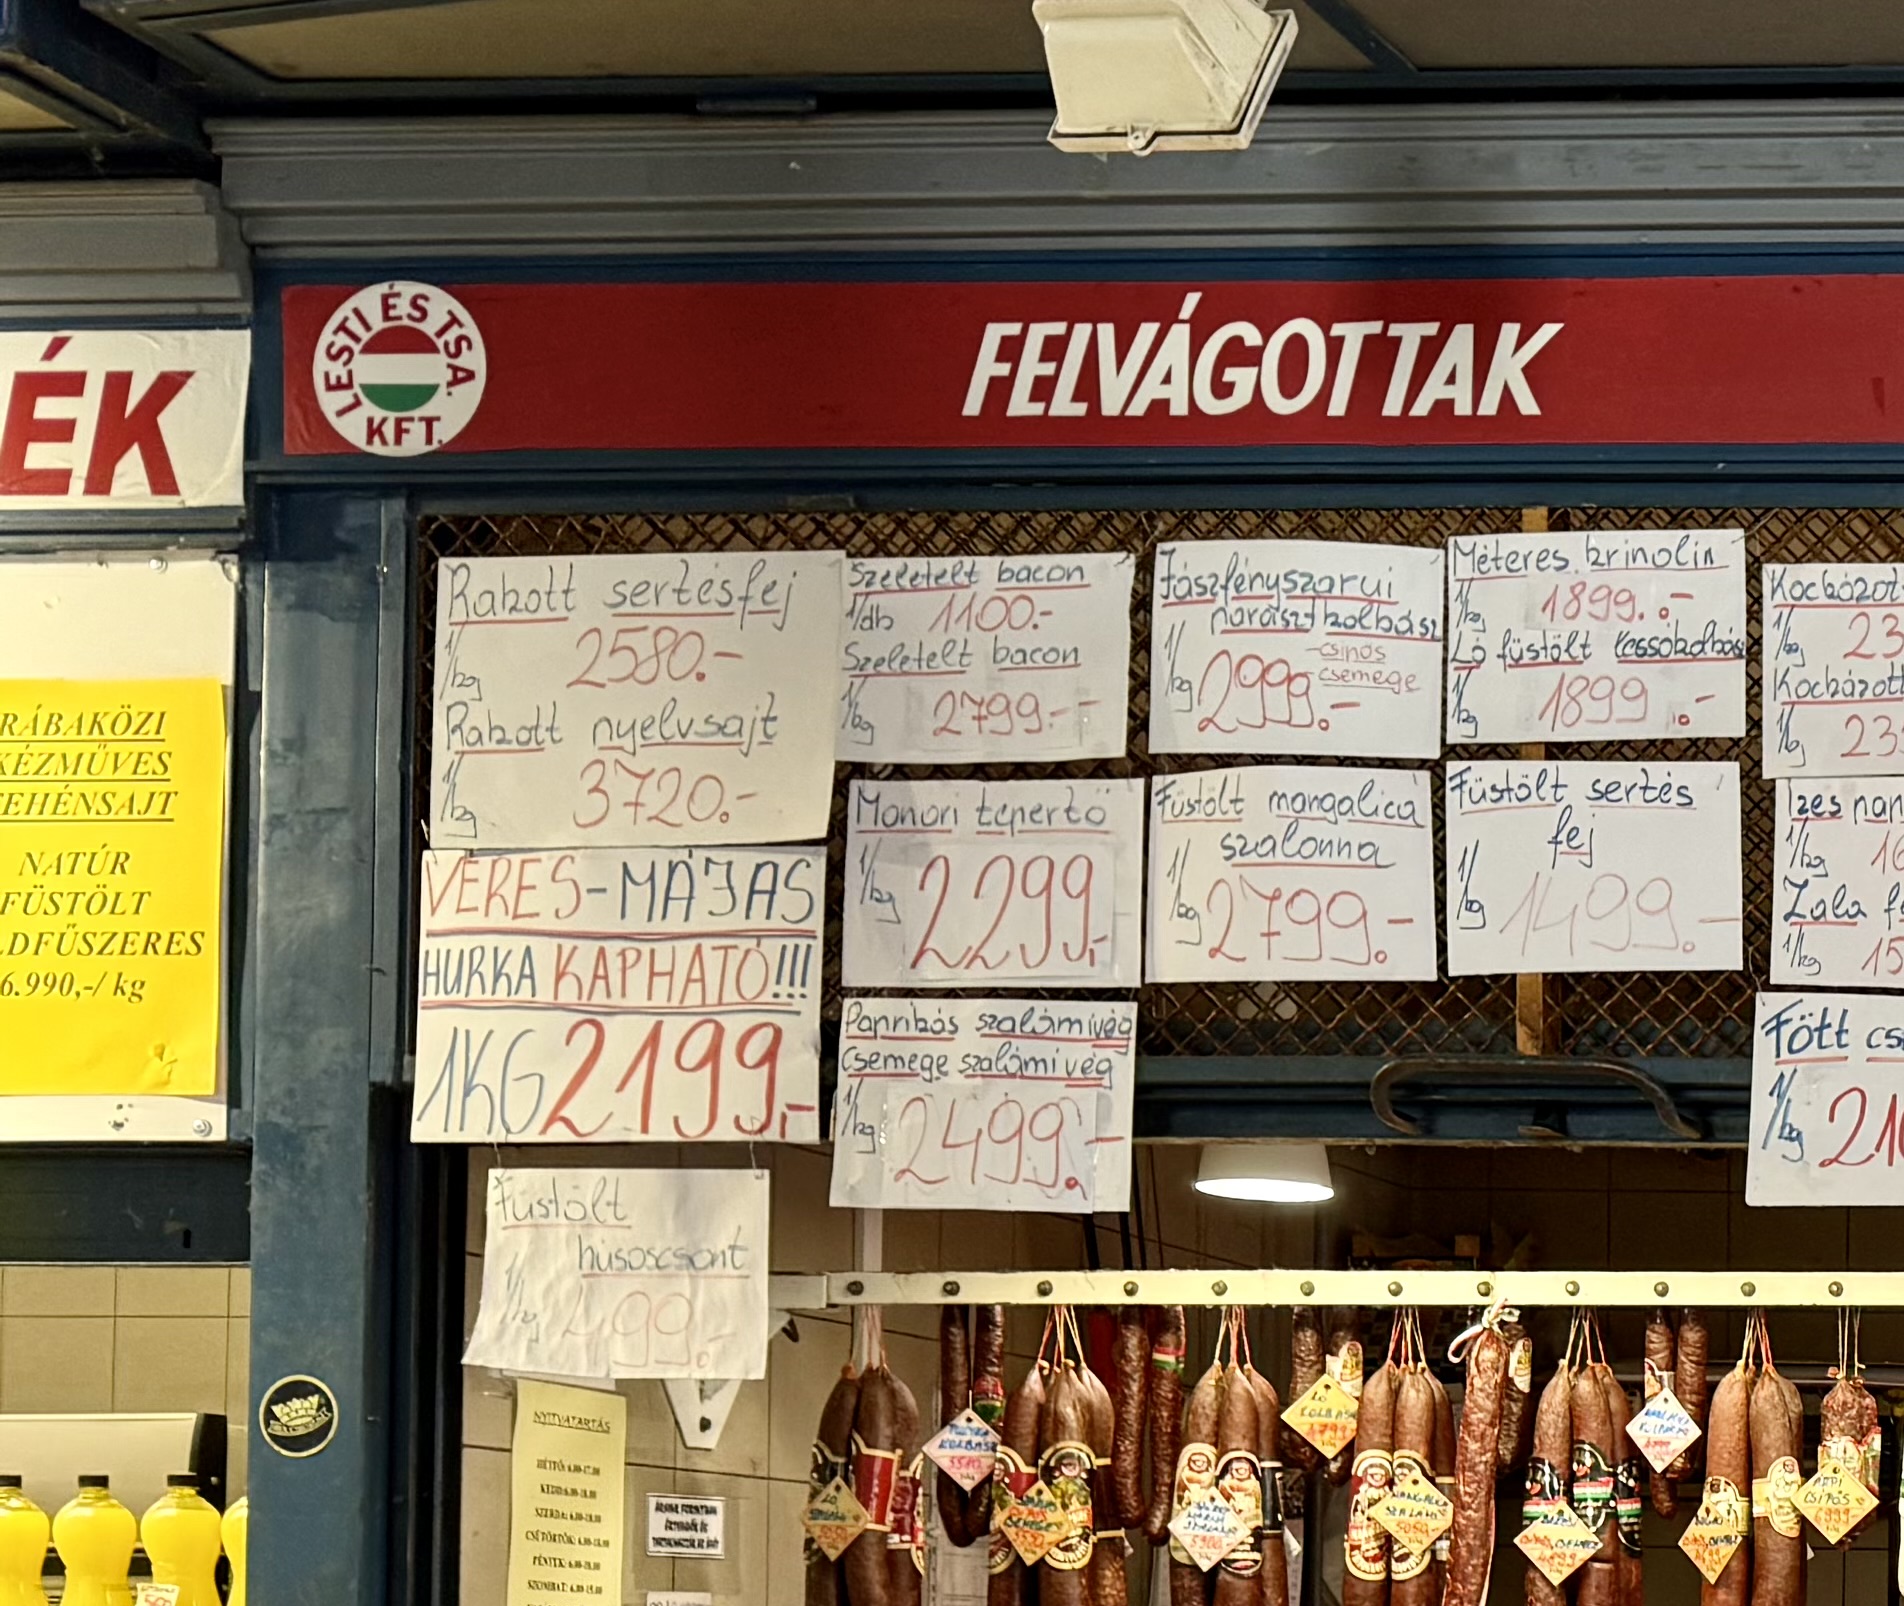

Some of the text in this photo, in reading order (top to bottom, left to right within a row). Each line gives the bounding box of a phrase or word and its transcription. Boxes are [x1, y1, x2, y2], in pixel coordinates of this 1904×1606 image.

[324, 306, 373, 417] LESTI
[380, 282, 432, 324] ÉS
[962, 291, 1564, 418] FELVÁGOTTAK
[366, 416, 443, 446] KFT.
[849, 560, 1085, 591] Szeletelt bacon
[844, 638, 1081, 672] Szeletelt bacon
[0, 704, 166, 737] RÁBAKÖZI
[1589, 770, 1694, 805] sertés
[855, 786, 958, 827] Monori
[1220, 819, 1396, 869] szalonna
[1548, 812, 1594, 869] fej
[19, 844, 131, 877] NATÚR
[0, 884, 152, 916] FÜSTÖLT
[1783, 879, 1866, 921] Zala
[113, 972, 146, 1003] kg
[422, 948, 537, 1000] HURKA
